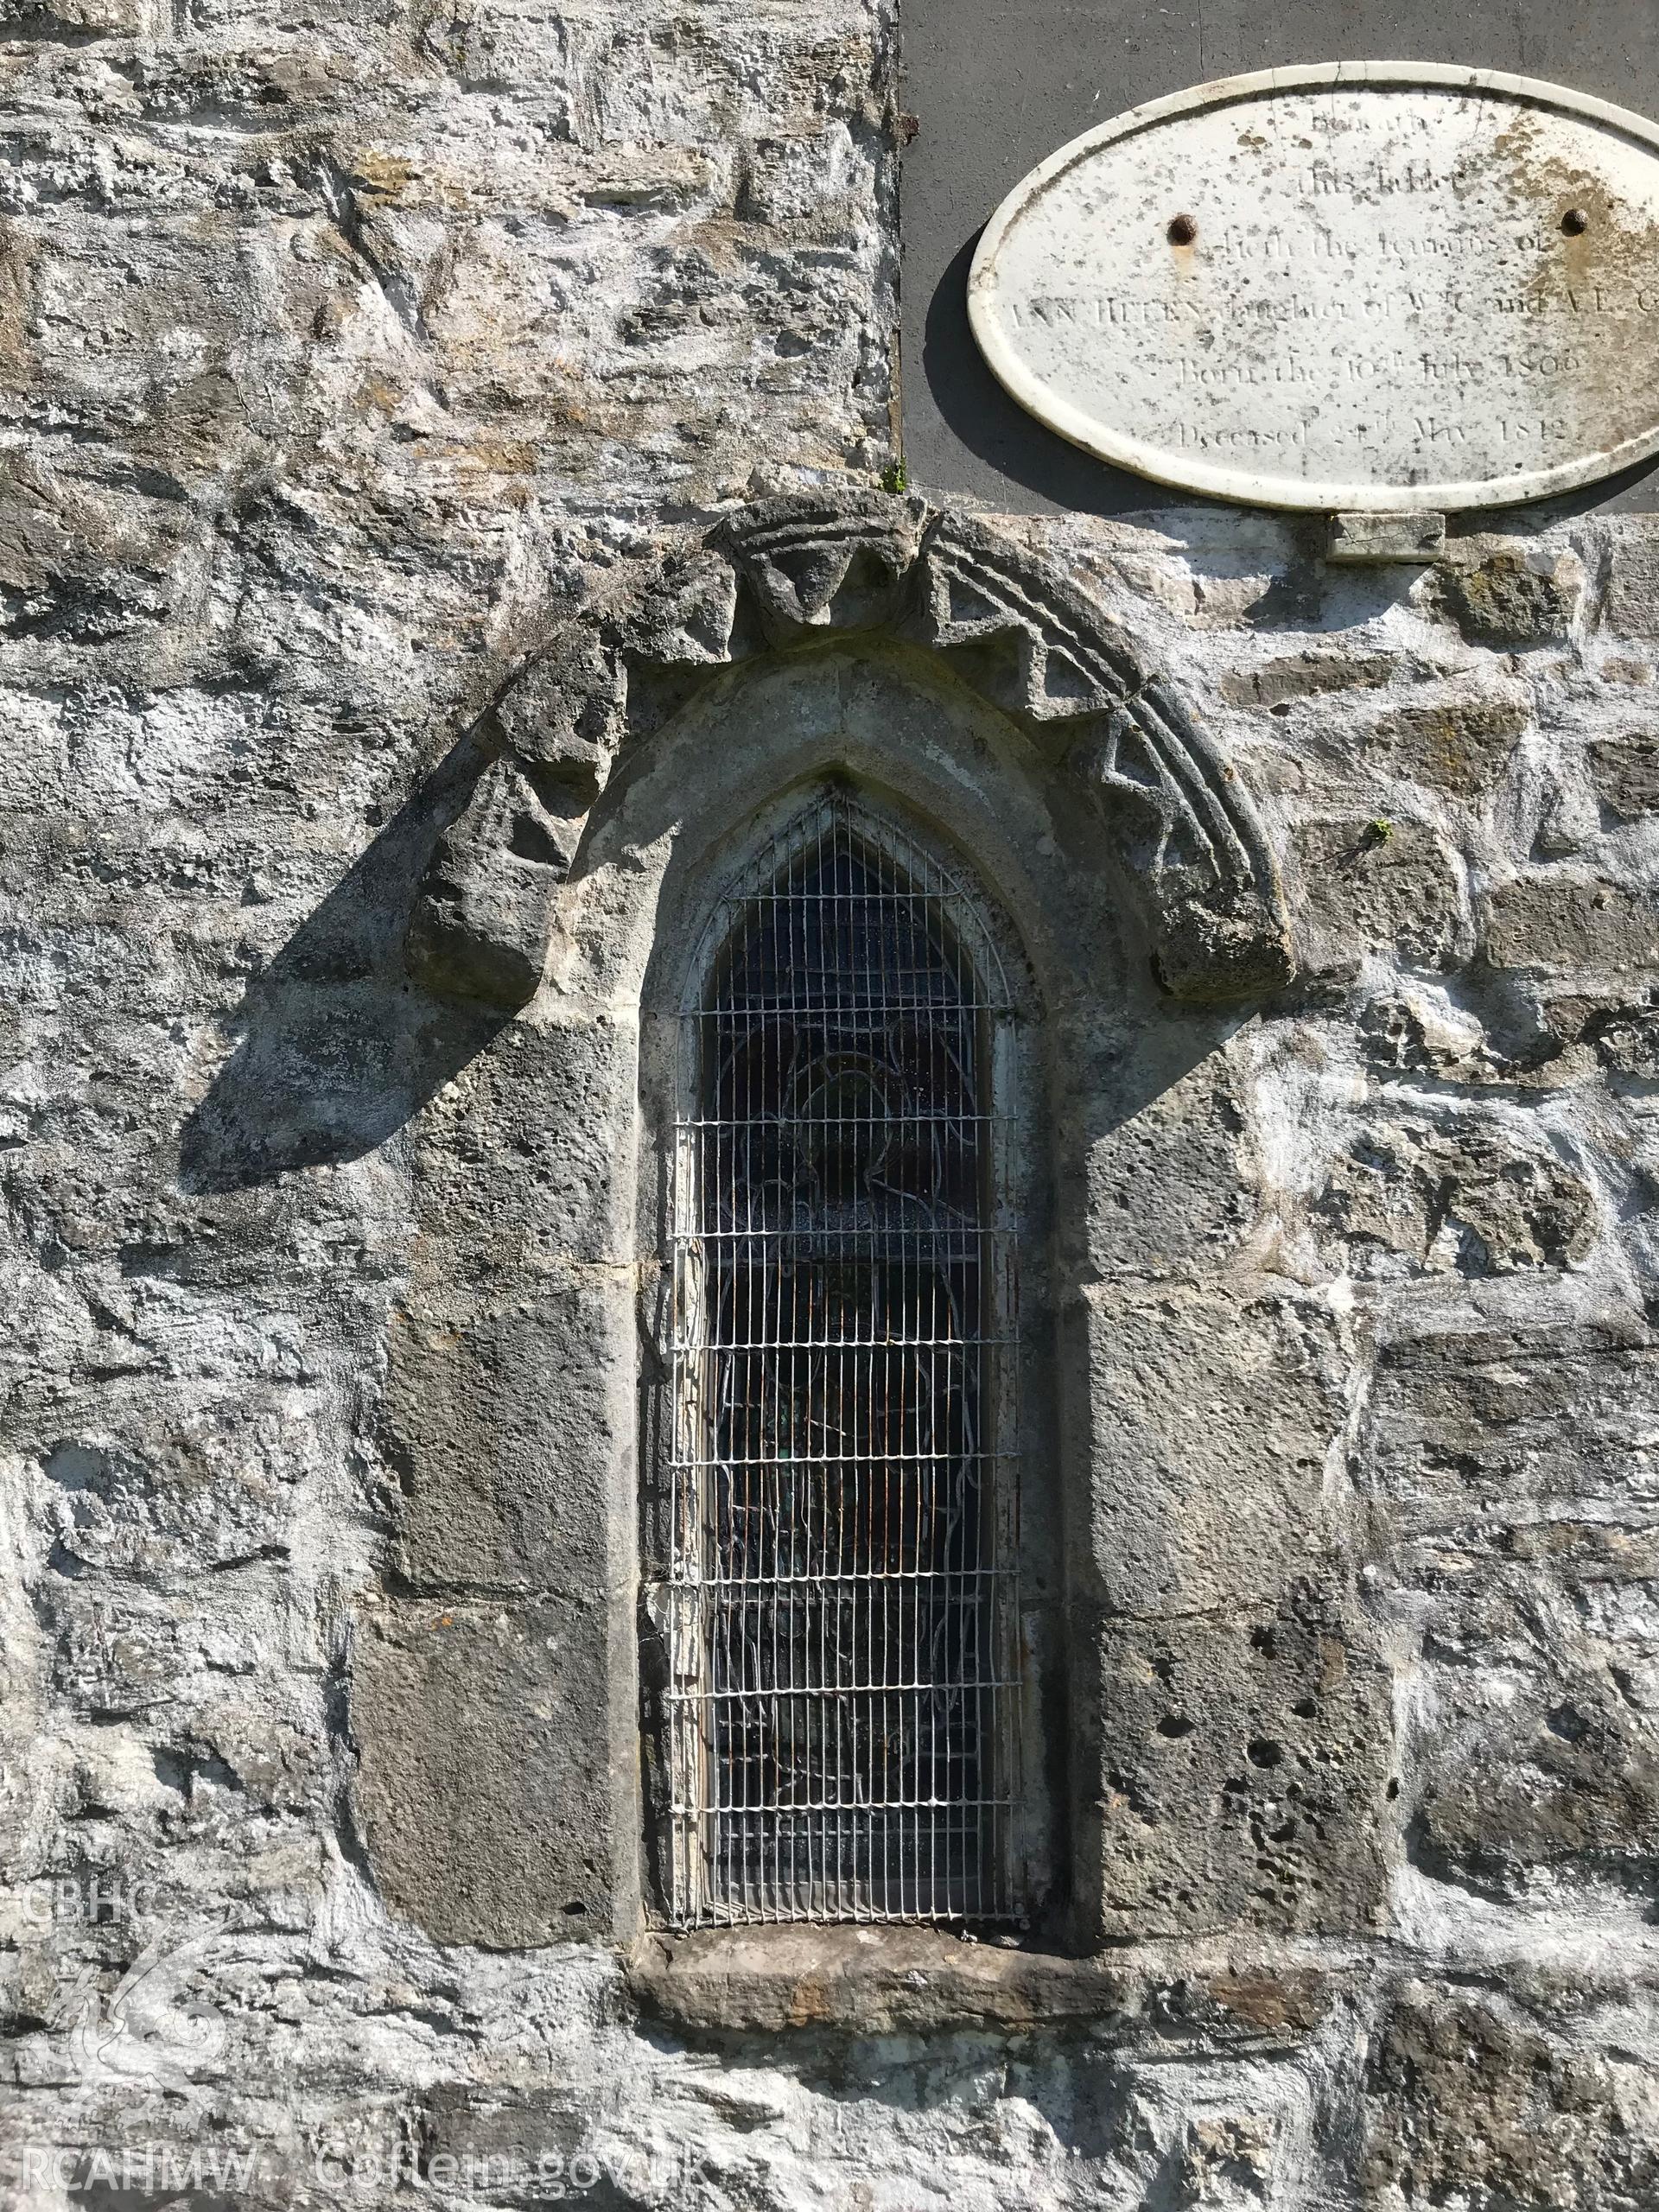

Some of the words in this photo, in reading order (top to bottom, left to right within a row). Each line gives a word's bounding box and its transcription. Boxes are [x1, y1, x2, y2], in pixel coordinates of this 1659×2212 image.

[1312, 227, 1357, 257] the
[1178, 358, 1258, 385] Born
[1273, 355, 1318, 382] the
[1177, 420, 1310, 449] Deceased
